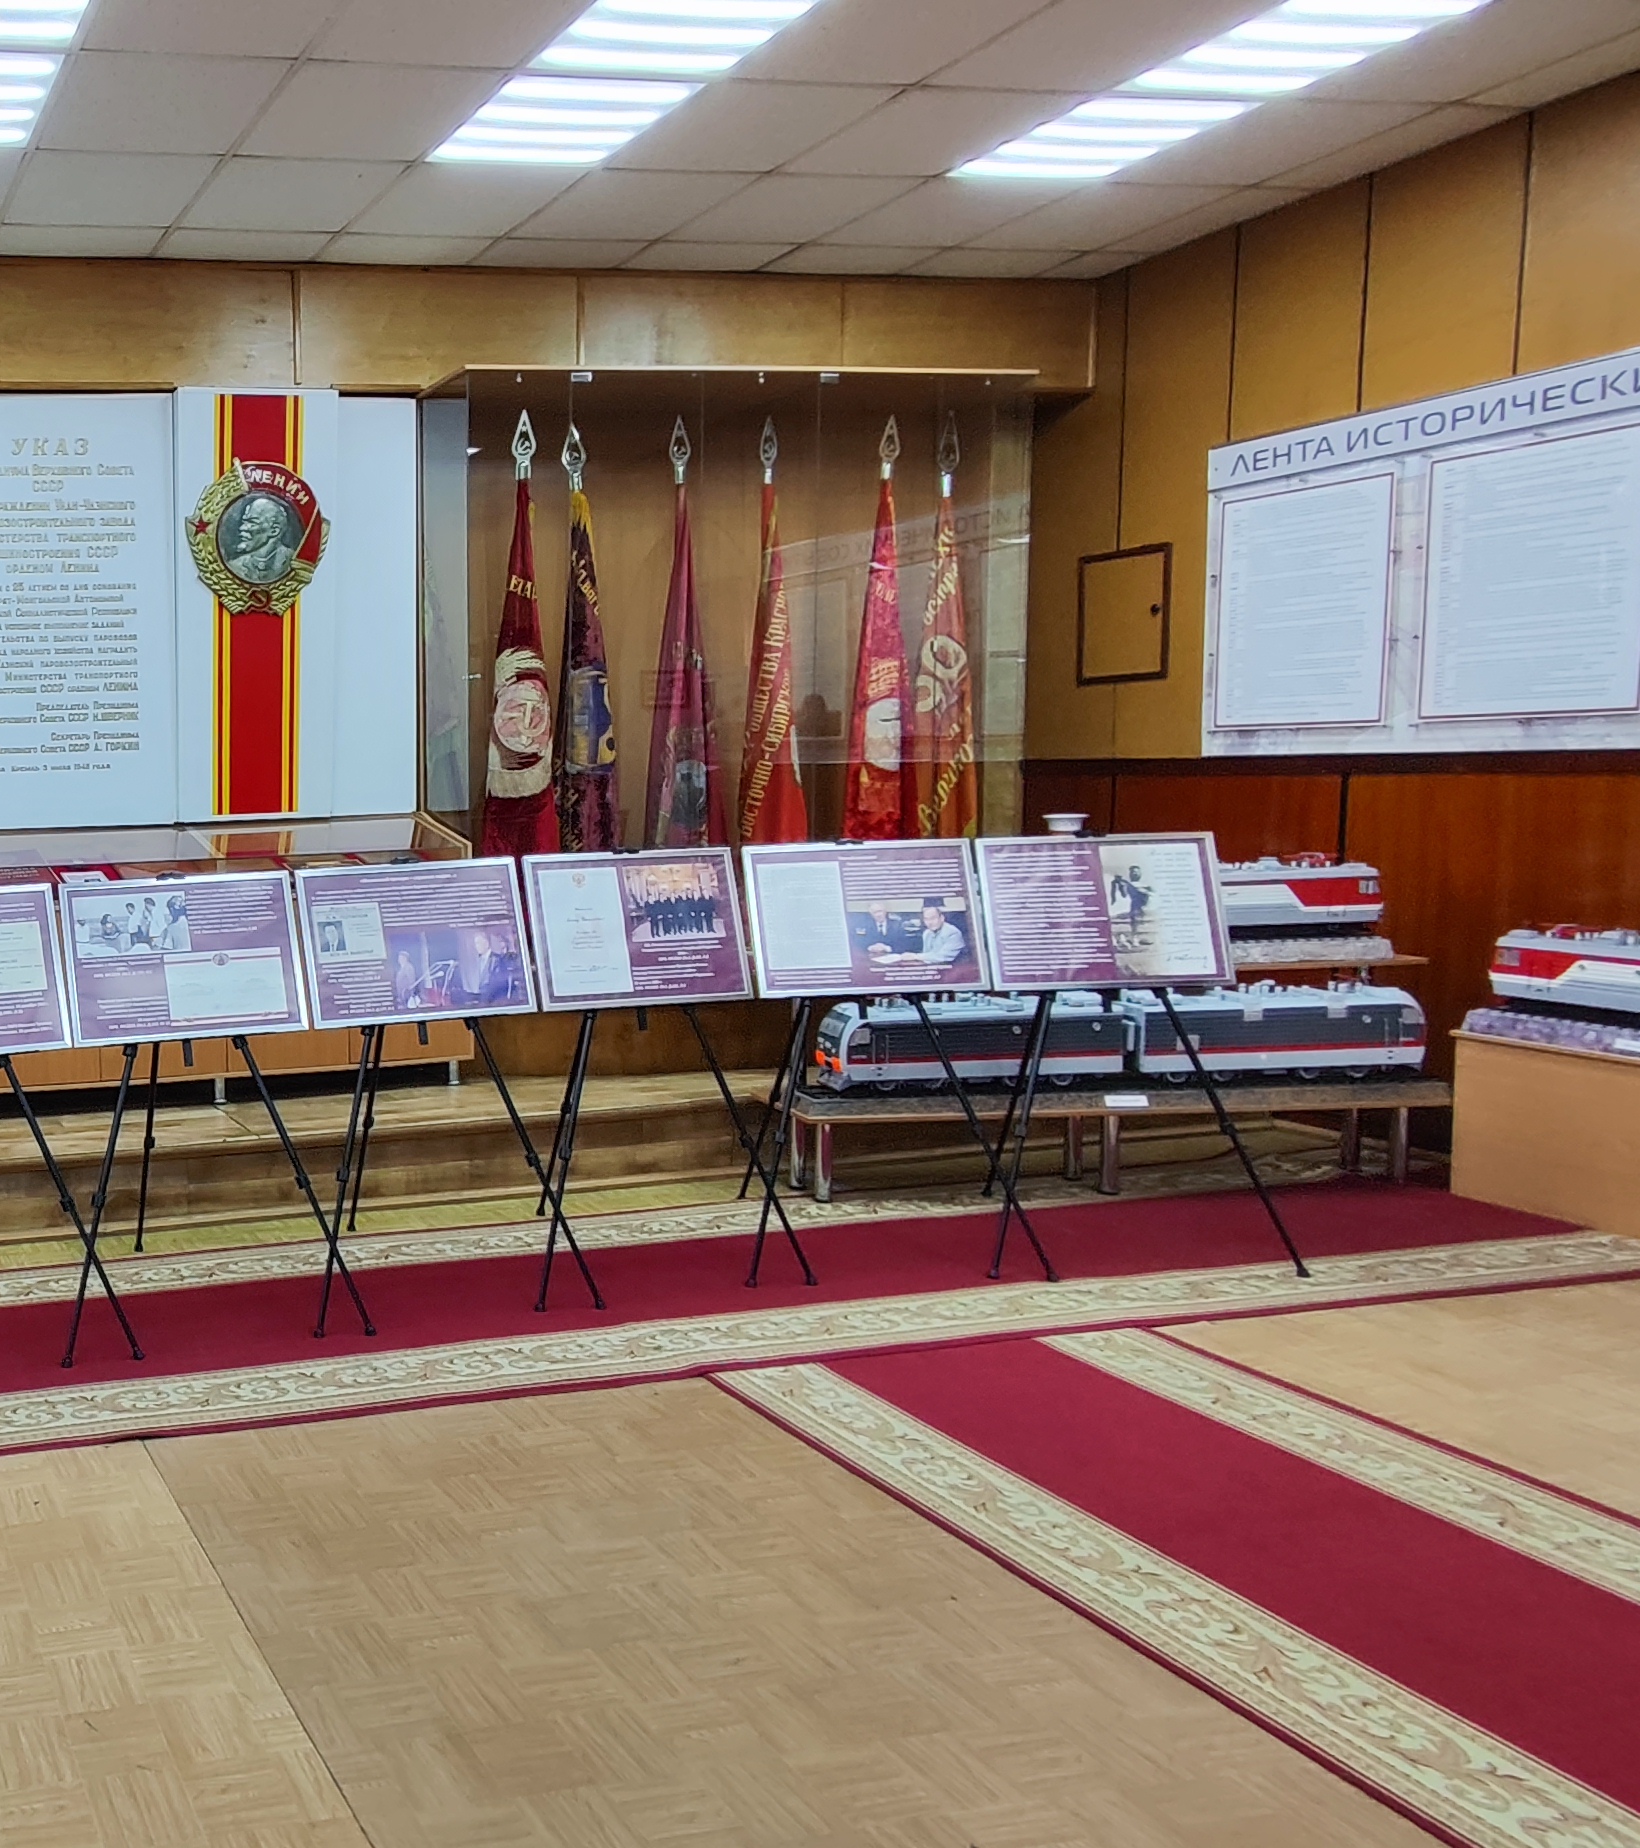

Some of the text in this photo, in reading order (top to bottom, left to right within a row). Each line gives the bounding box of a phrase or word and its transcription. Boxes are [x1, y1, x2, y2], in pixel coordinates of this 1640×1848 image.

[11, 438, 89, 456] УКАЗ
[1230, 436, 1335, 477] ЛЕНТА
[32, 480, 64, 492] СССР
[250, 468, 310, 505] ЛЕНИН
[87, 546, 118, 558] СССР
